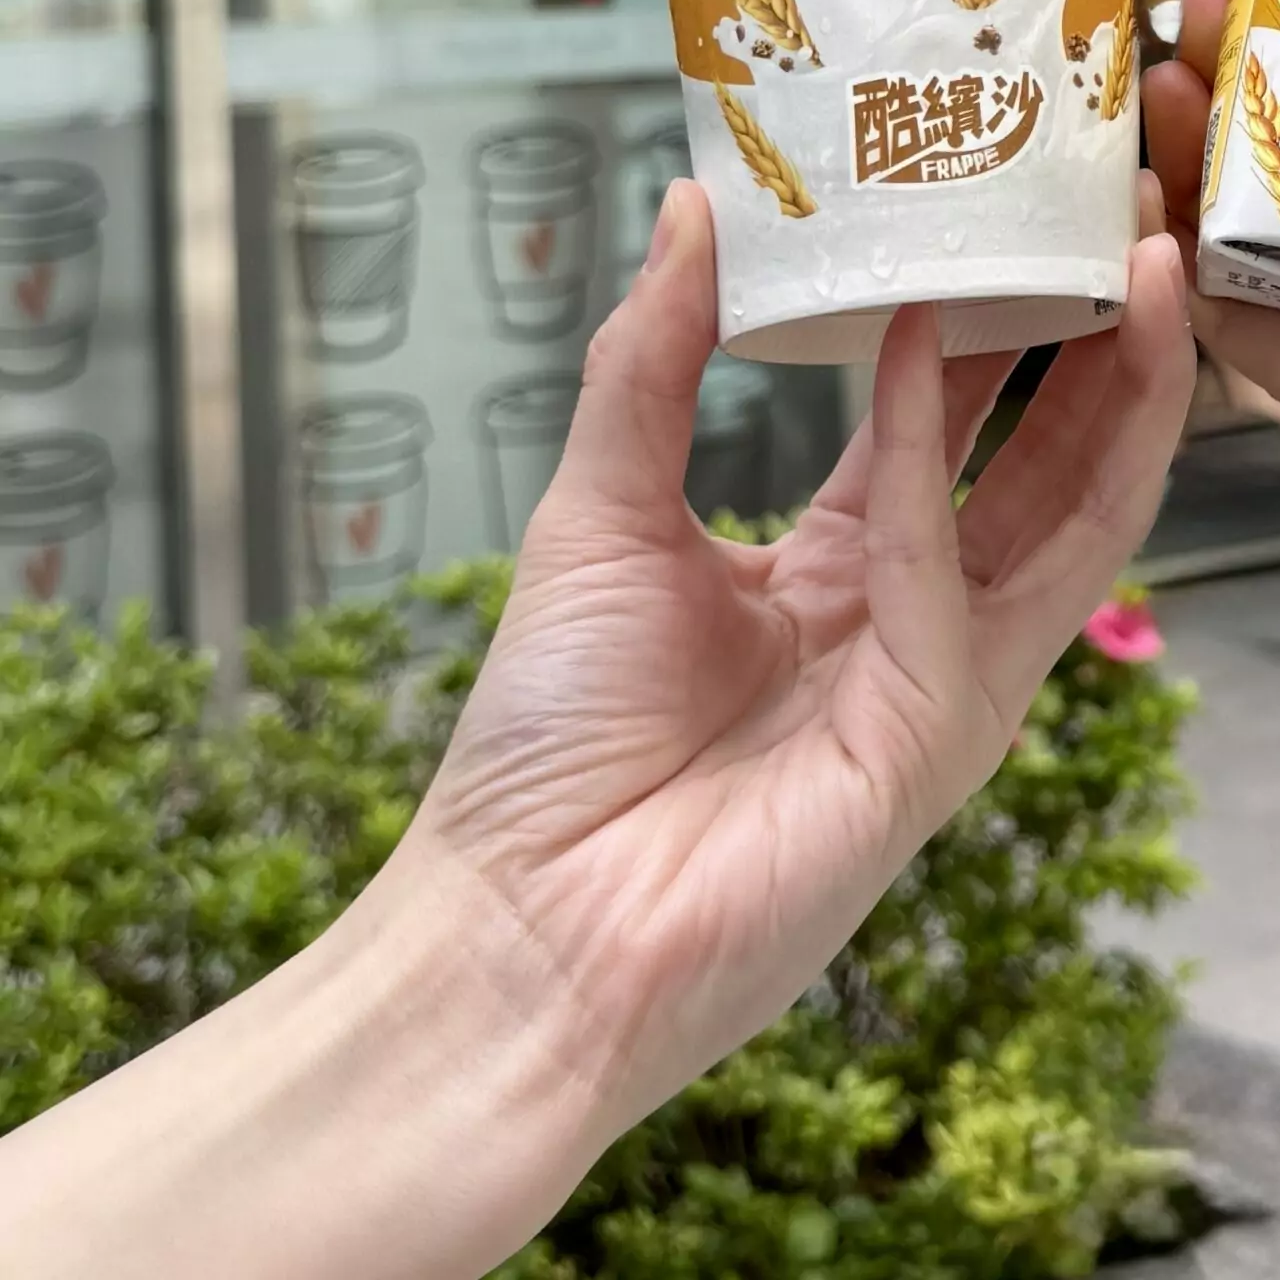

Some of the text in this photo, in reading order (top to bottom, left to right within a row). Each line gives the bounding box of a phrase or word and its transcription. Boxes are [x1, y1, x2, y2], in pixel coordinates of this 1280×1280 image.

[852, 71, 1044, 184] 酷繽沙
[920, 146, 1001, 182] FRAPPE
